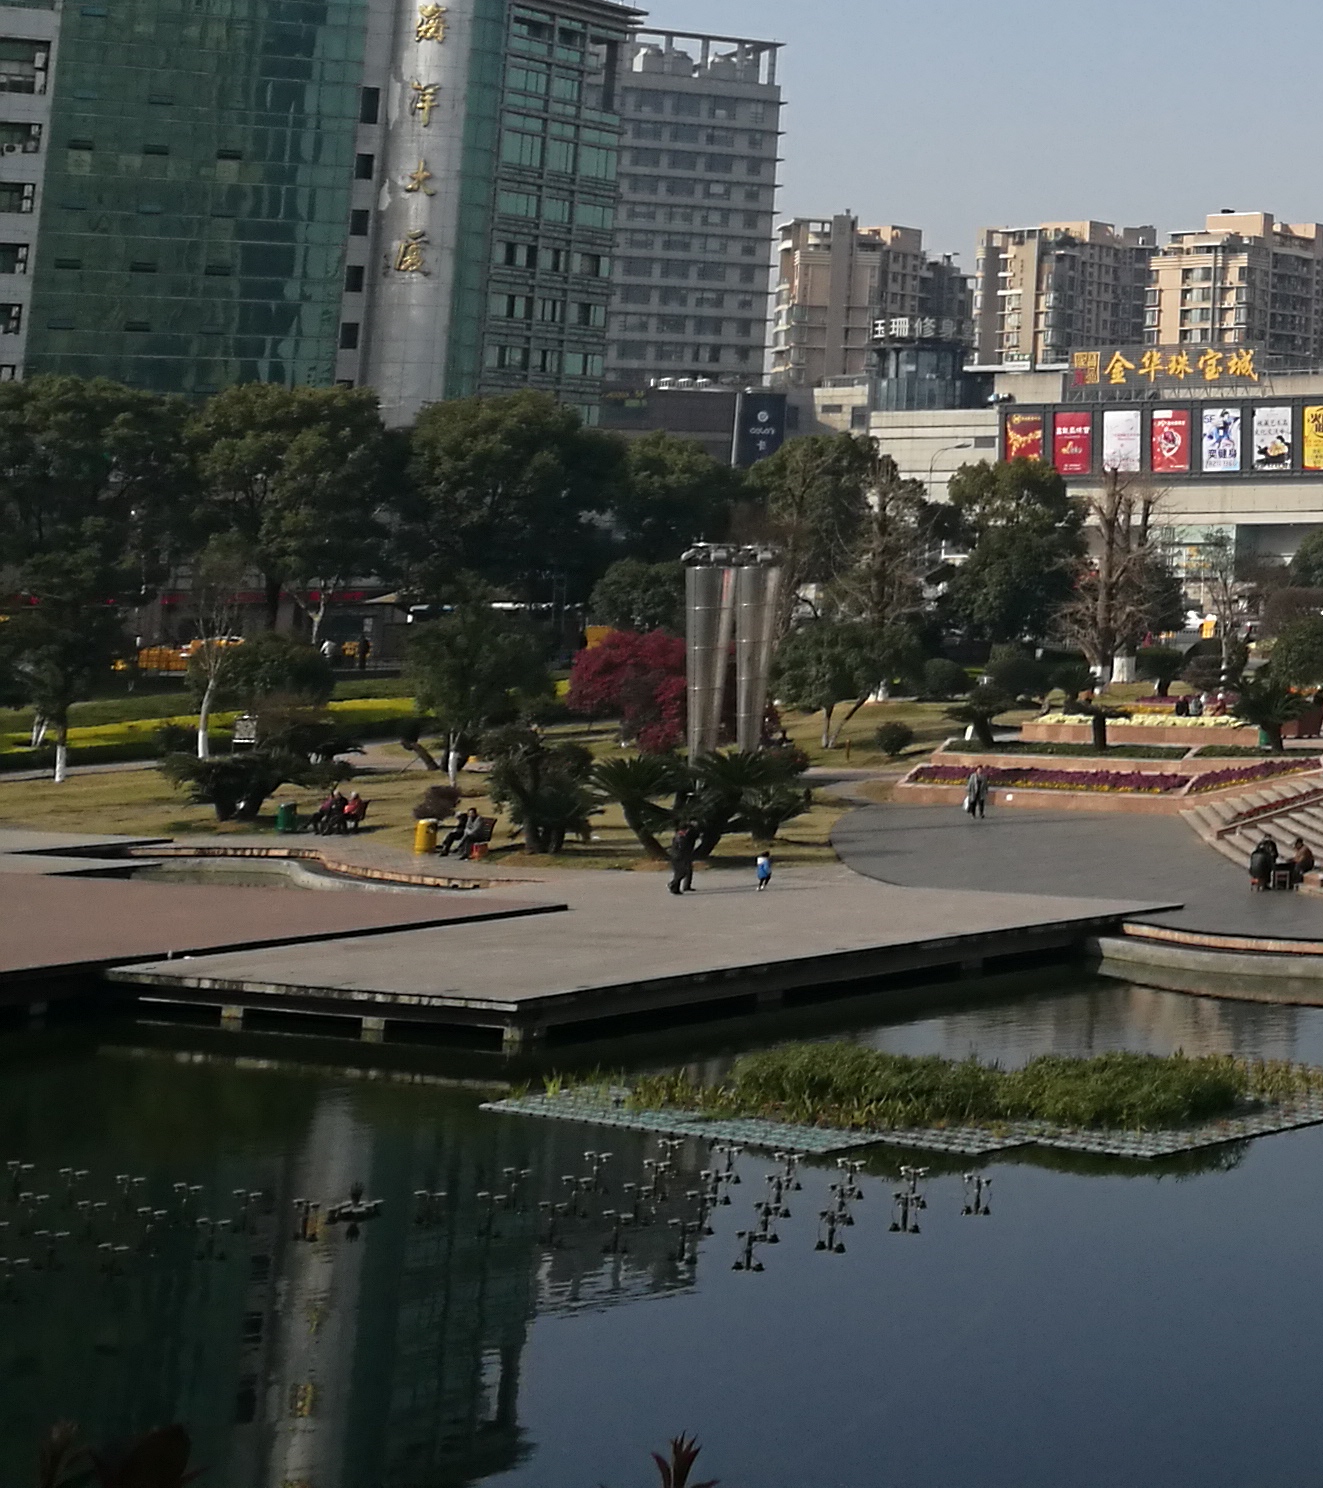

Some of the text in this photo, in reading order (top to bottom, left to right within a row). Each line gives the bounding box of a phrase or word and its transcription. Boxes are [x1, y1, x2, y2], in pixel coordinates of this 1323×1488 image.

[1104, 348, 1260, 384] 金华珠宝城
